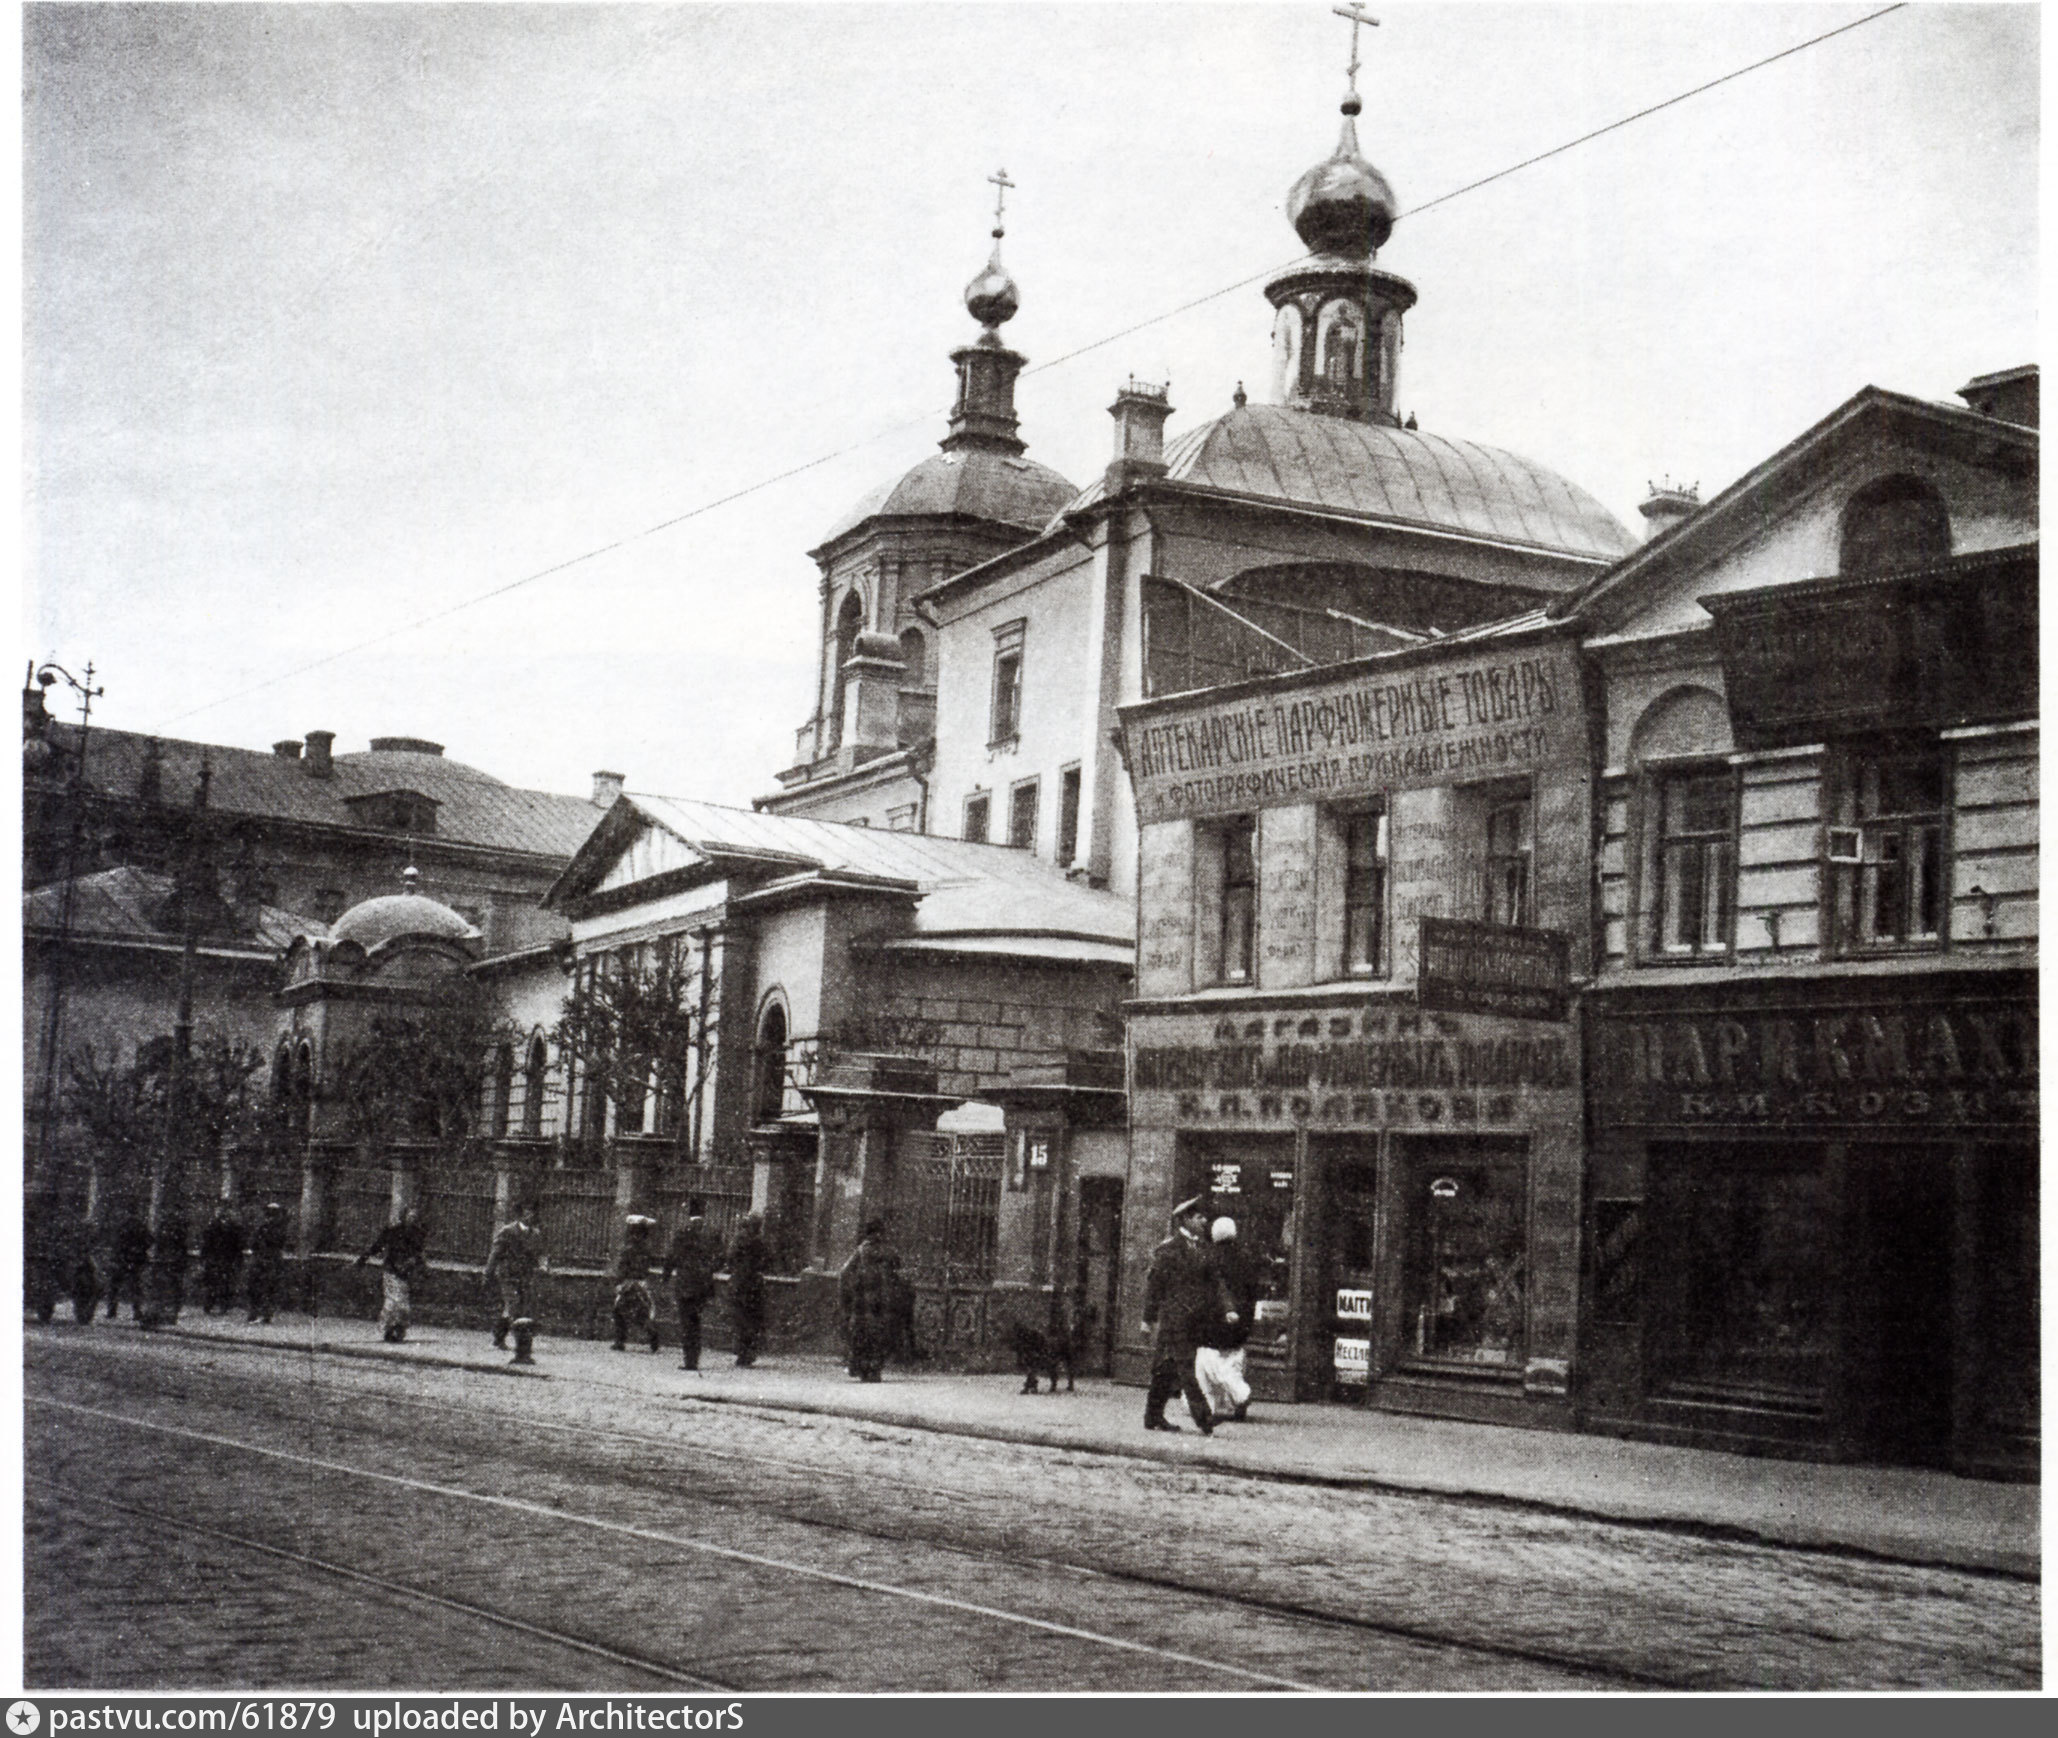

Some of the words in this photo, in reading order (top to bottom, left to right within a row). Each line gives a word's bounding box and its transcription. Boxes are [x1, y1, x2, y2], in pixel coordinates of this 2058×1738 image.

[1140, 706, 1271, 778] АПТЕКАРСКІЕ
[1274, 677, 1456, 756] ПАРФЮМЕРНЫЕ
[1456, 658, 1561, 726] ТОВАРЫ
[1347, 727, 1552, 785] ПРИНАДЛЕЖНОСТИ
[1030, 1143, 1049, 1168] 15
